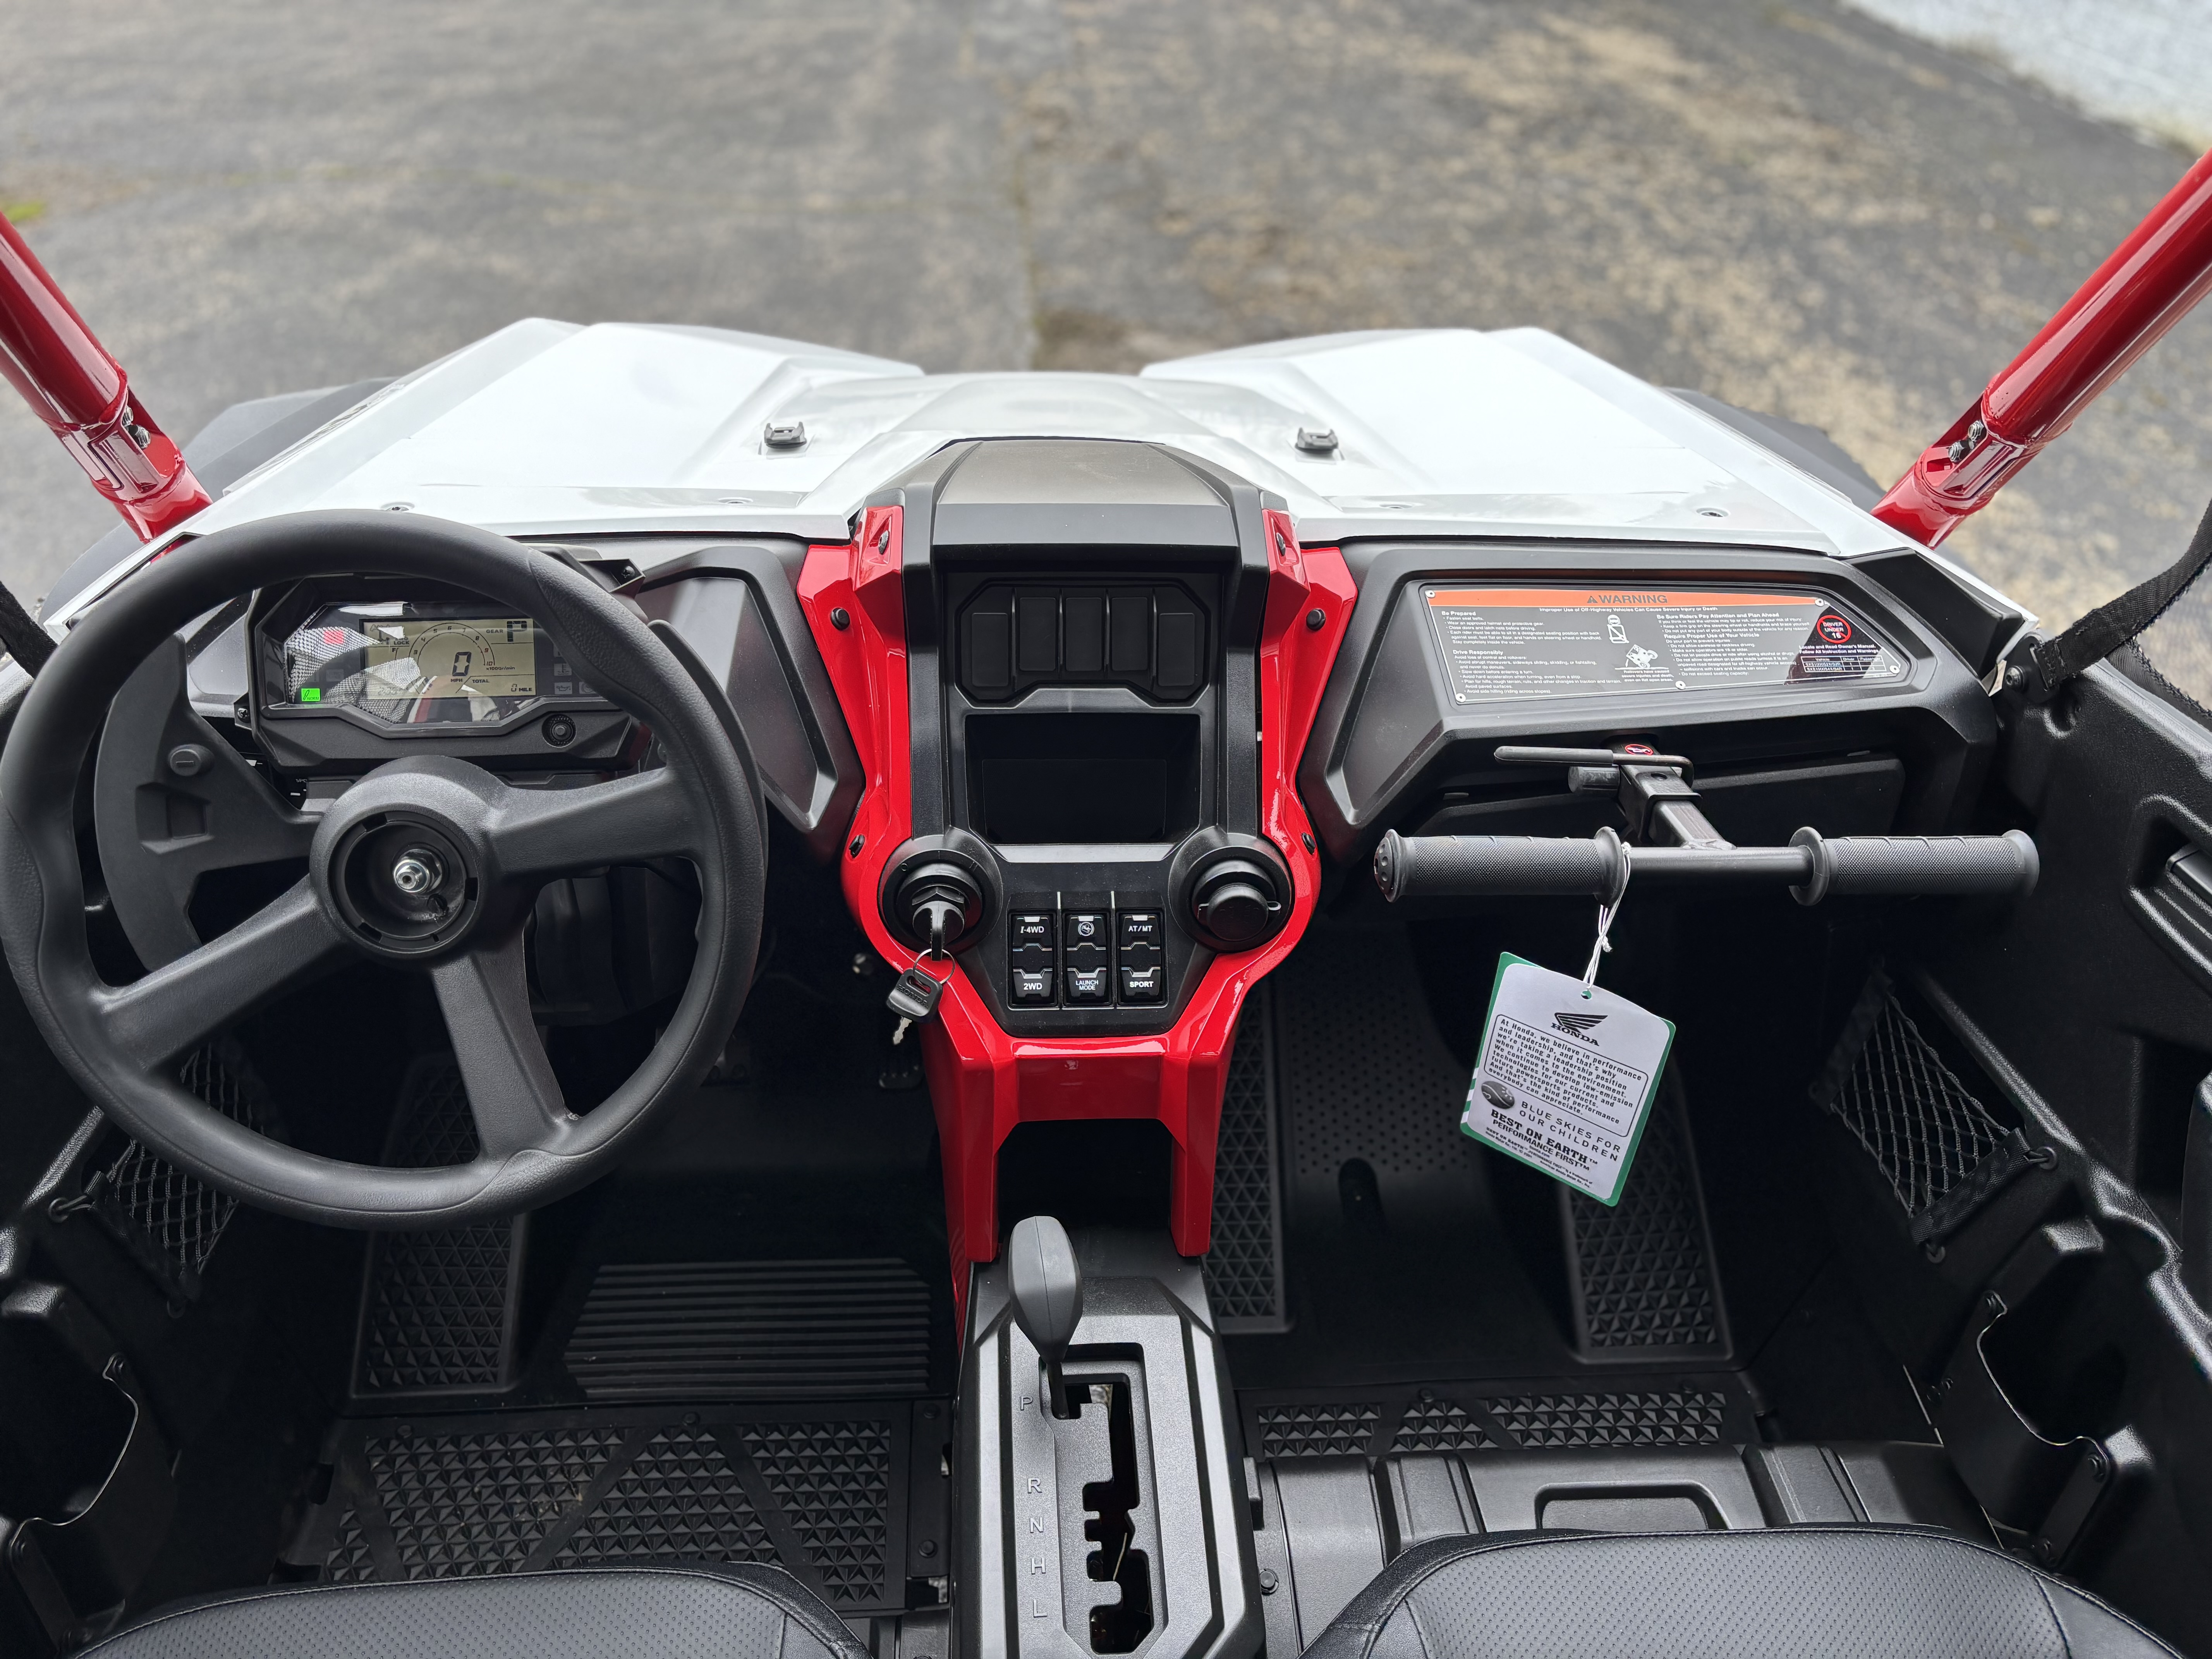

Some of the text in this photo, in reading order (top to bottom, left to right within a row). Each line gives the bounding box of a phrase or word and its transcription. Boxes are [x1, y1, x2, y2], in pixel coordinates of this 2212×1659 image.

[1599, 595, 1667, 603] WARNING
[452, 651, 472, 677] 0
[896, 984, 928, 1008] HONDA
[1499, 1027, 1512, 1035] and
[1559, 1052, 1573, 1060] and
[1576, 1058, 1599, 1071] that's
[1602, 1068, 1616, 1079] why
[1501, 1018, 1509, 1027] At
[1553, 1040, 1580, 1056] believe
[1592, 1058, 1642, 1080] performance
[1551, 1022, 1599, 1046] HONDA
[1493, 1050, 1614, 1107] technologies for our current and
[1495, 1044, 1504, 1053] We
[1507, 1051, 1539, 1068] continue
[1552, 1070, 1580, 1085] develop
[1583, 1082, 1633, 1108] low-emission
[1496, 1039, 1514, 1050] when
[1526, 1052, 1549, 1065] comes
[1563, 1066, 1575, 1076] the
[1578, 1074, 1626, 1098] environment.
[1498, 1032, 1517, 1044] we're
[1521, 1041, 1544, 1056] taking
[1554, 1055, 1593, 1076] leadership
[1595, 1074, 1627, 1090] position
[1489, 1068, 1583, 1115] everybody can appreciate.
[1490, 1061, 1503, 1071] And
[1506, 1069, 1527, 1082] that's
[1530, 1080, 1541, 1089] the
[1544, 1087, 1560, 1097] kind
[1572, 1100, 1620, 1124] performance
[1492, 1056, 1598, 1108] future powersports products.
[1491, 1109, 1523, 1130] BEST
[1526, 1128, 1543, 1141] ON
[1493, 1119, 1554, 1155] PERFORMANCE
[1520, 1110, 1544, 1127] OUR
[1550, 1125, 1618, 1161] CHILDREN
[1522, 1101, 1620, 1152] BLUE SKIES FOR
[1020, 1396, 1033, 1410] P
[1027, 1478, 1042, 1493] R
[1029, 1518, 1044, 1533] N
[1031, 1558, 1046, 1574] H
[1033, 1600, 1047, 1618] L
